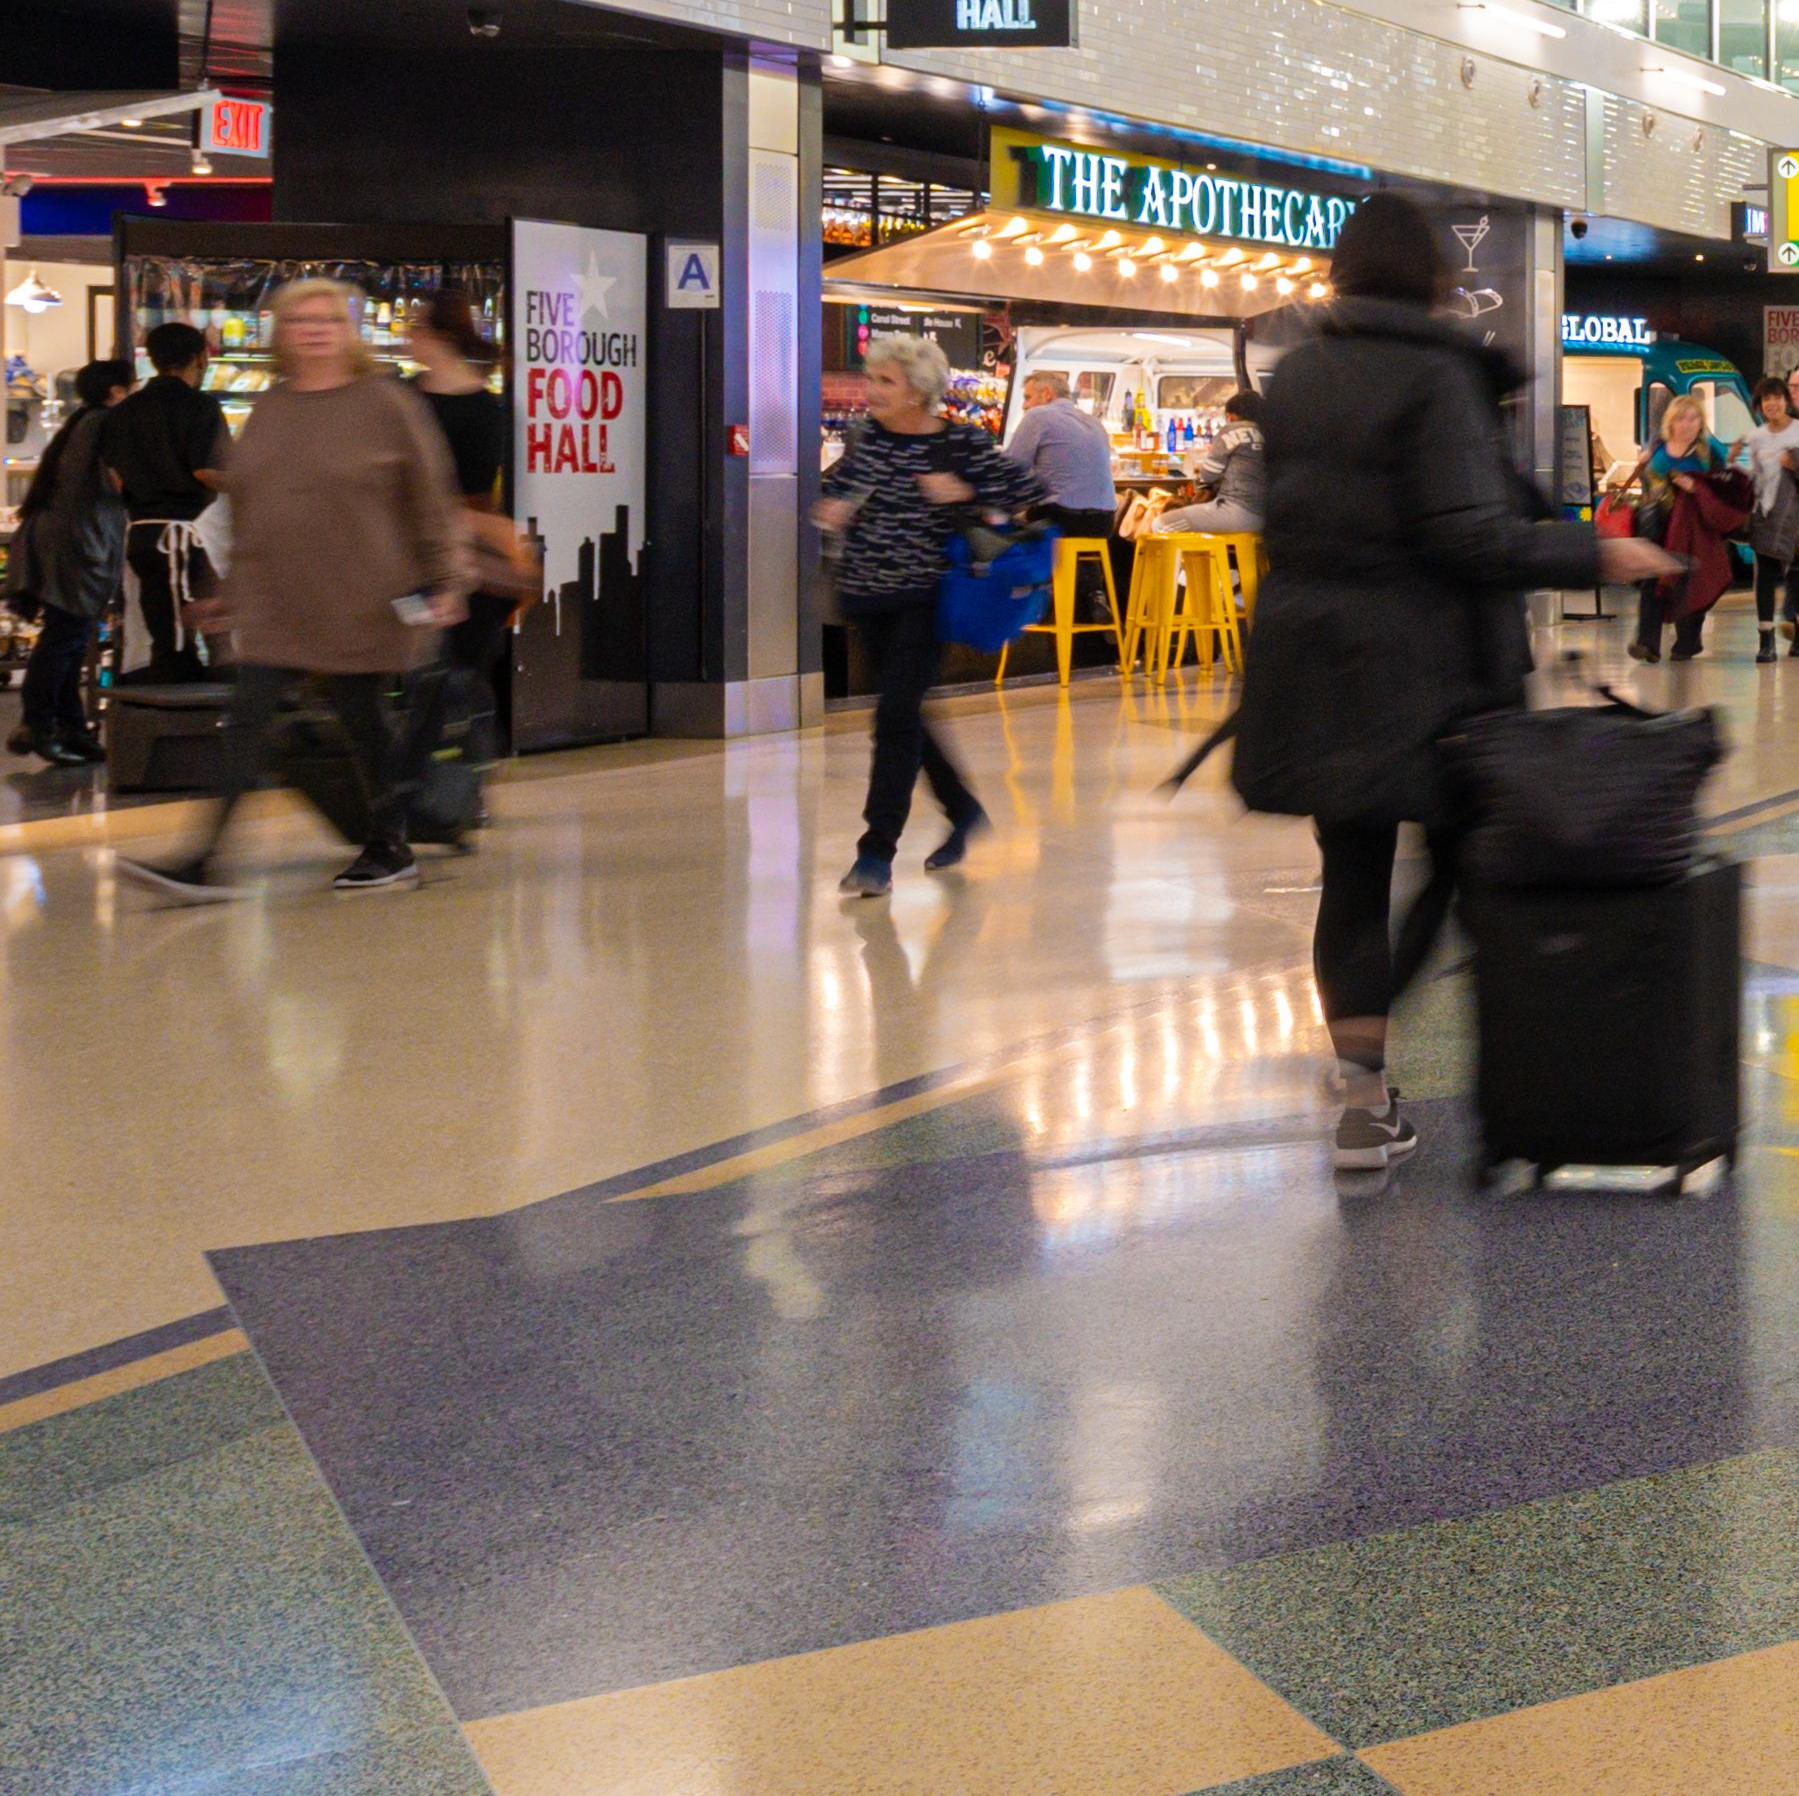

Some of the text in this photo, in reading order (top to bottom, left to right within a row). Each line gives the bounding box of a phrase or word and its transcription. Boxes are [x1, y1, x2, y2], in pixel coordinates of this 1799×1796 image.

[956, 0, 1036, 30] HALL
[212, 99, 264, 151] EXIT
[1041, 144, 1357, 249] THE APOTHECAR
[677, 253, 710, 290] A
[527, 290, 575, 326] FIVE
[1768, 311, 1799, 327] FIVE
[527, 328, 637, 368] BOROUGH
[527, 368, 623, 421] FOOD
[527, 423, 616, 474] HALL
